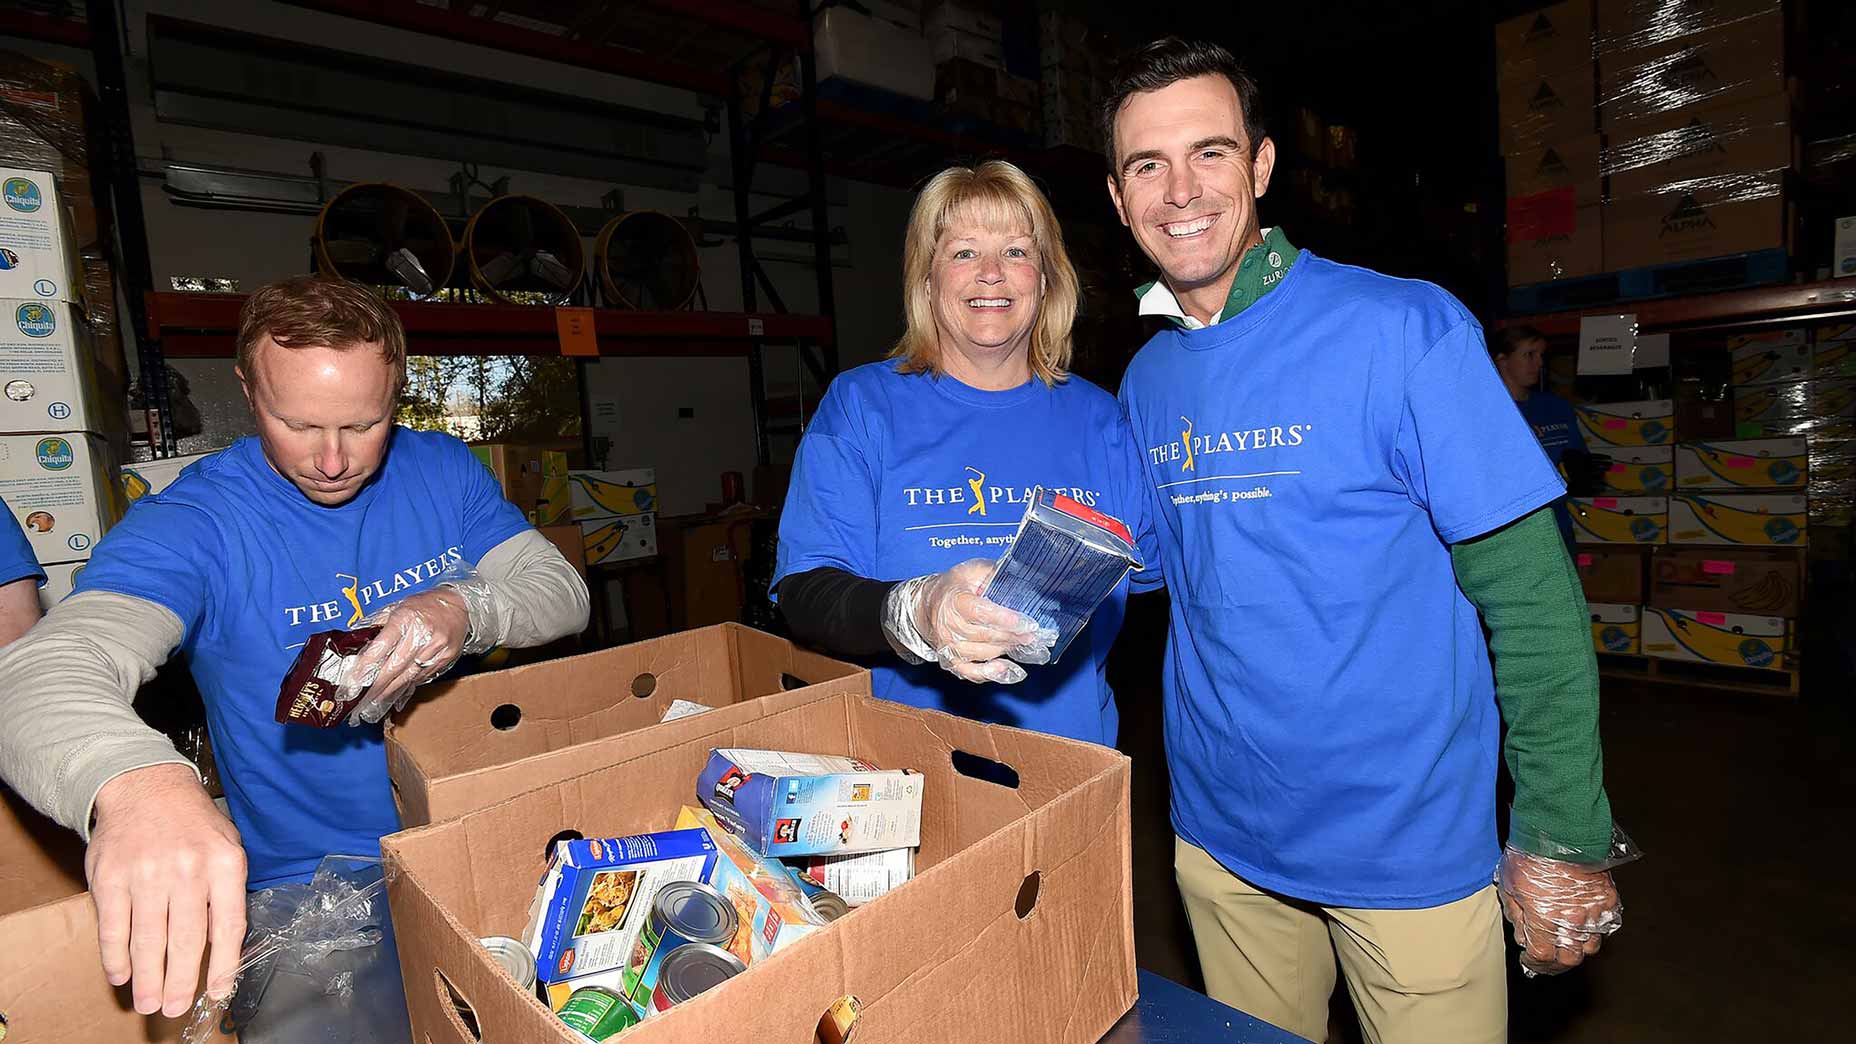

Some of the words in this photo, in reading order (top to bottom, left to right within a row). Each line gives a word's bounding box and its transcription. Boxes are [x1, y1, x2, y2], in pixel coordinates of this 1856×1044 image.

[5, 194, 41, 206] Chiquita
[1262, 262, 1293, 286] ZURI
[41, 282, 50, 294] L
[19, 321, 54, 332] Chiquita
[53, 405, 65, 417] H
[1150, 442, 1181, 465] THE
[1194, 424, 1303, 456] PLAYERS
[38, 454, 73, 466] Chiquita
[903, 487, 965, 506] THE
[990, 486, 1096, 507] PLARS
[1231, 486, 1273, 502] possible.
[74, 536, 85, 548] L
[928, 534, 984, 549] Together,
[985, 533, 1016, 546] anyth
[285, 600, 342, 627] THE
[360, 545, 463, 605] PLAYERS
